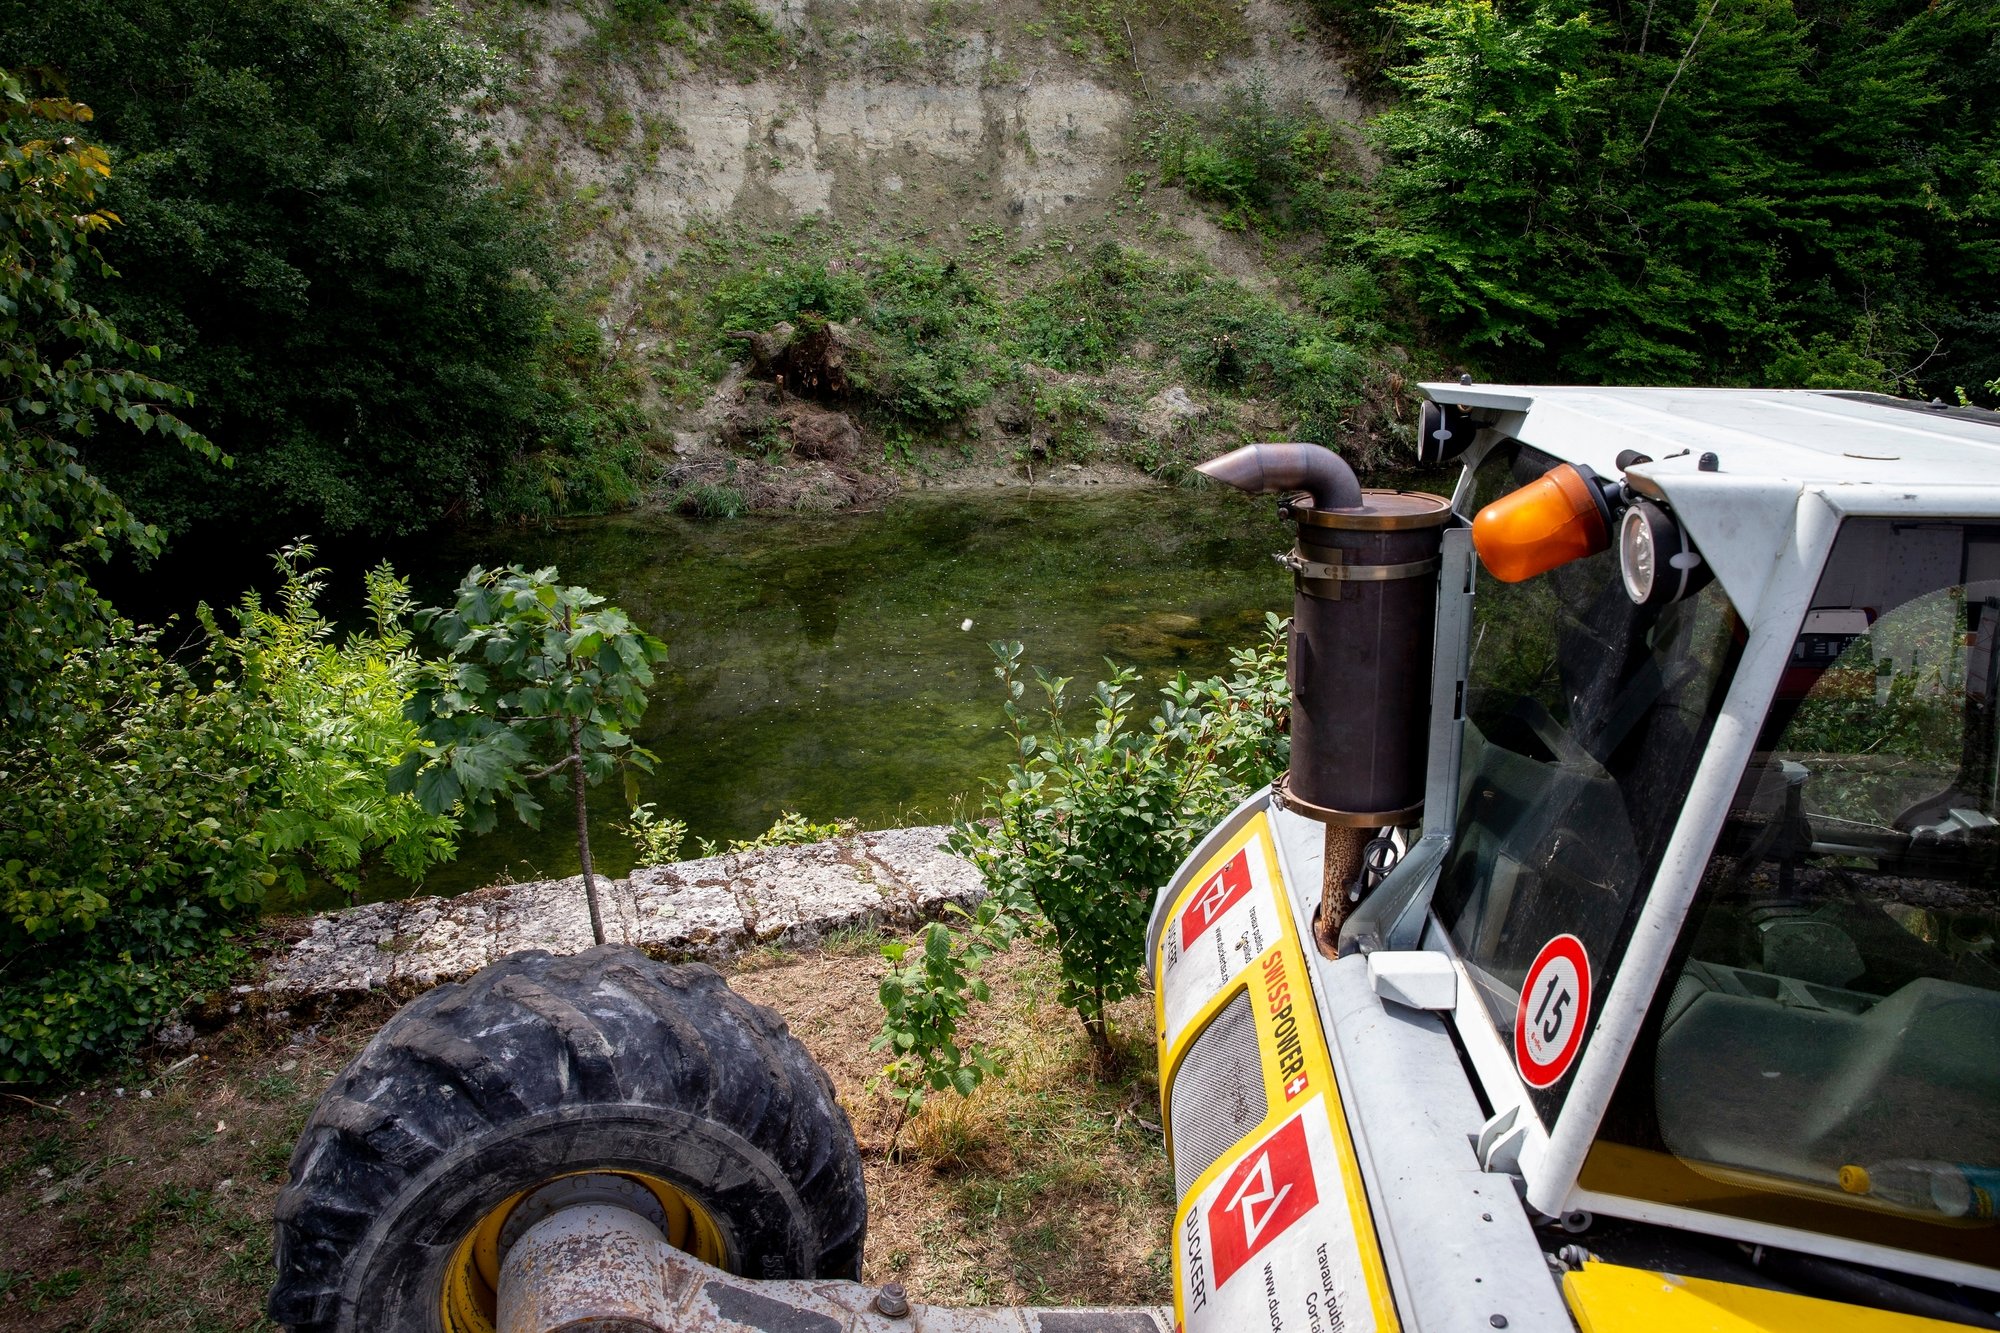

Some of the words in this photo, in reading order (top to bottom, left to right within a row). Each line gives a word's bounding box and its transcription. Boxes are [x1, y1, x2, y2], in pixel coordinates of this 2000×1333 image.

[1249, 906, 1258, 931] travaux
[1253, 930, 1263, 954] publics
[1262, 950, 1304, 1083] SWISSPOWER
[1534, 974, 1571, 1043] 15
[1186, 1206, 1207, 1314] DUCKERT
[1316, 1242, 1334, 1297] travaux
[1324, 1295, 1345, 1333] publi
